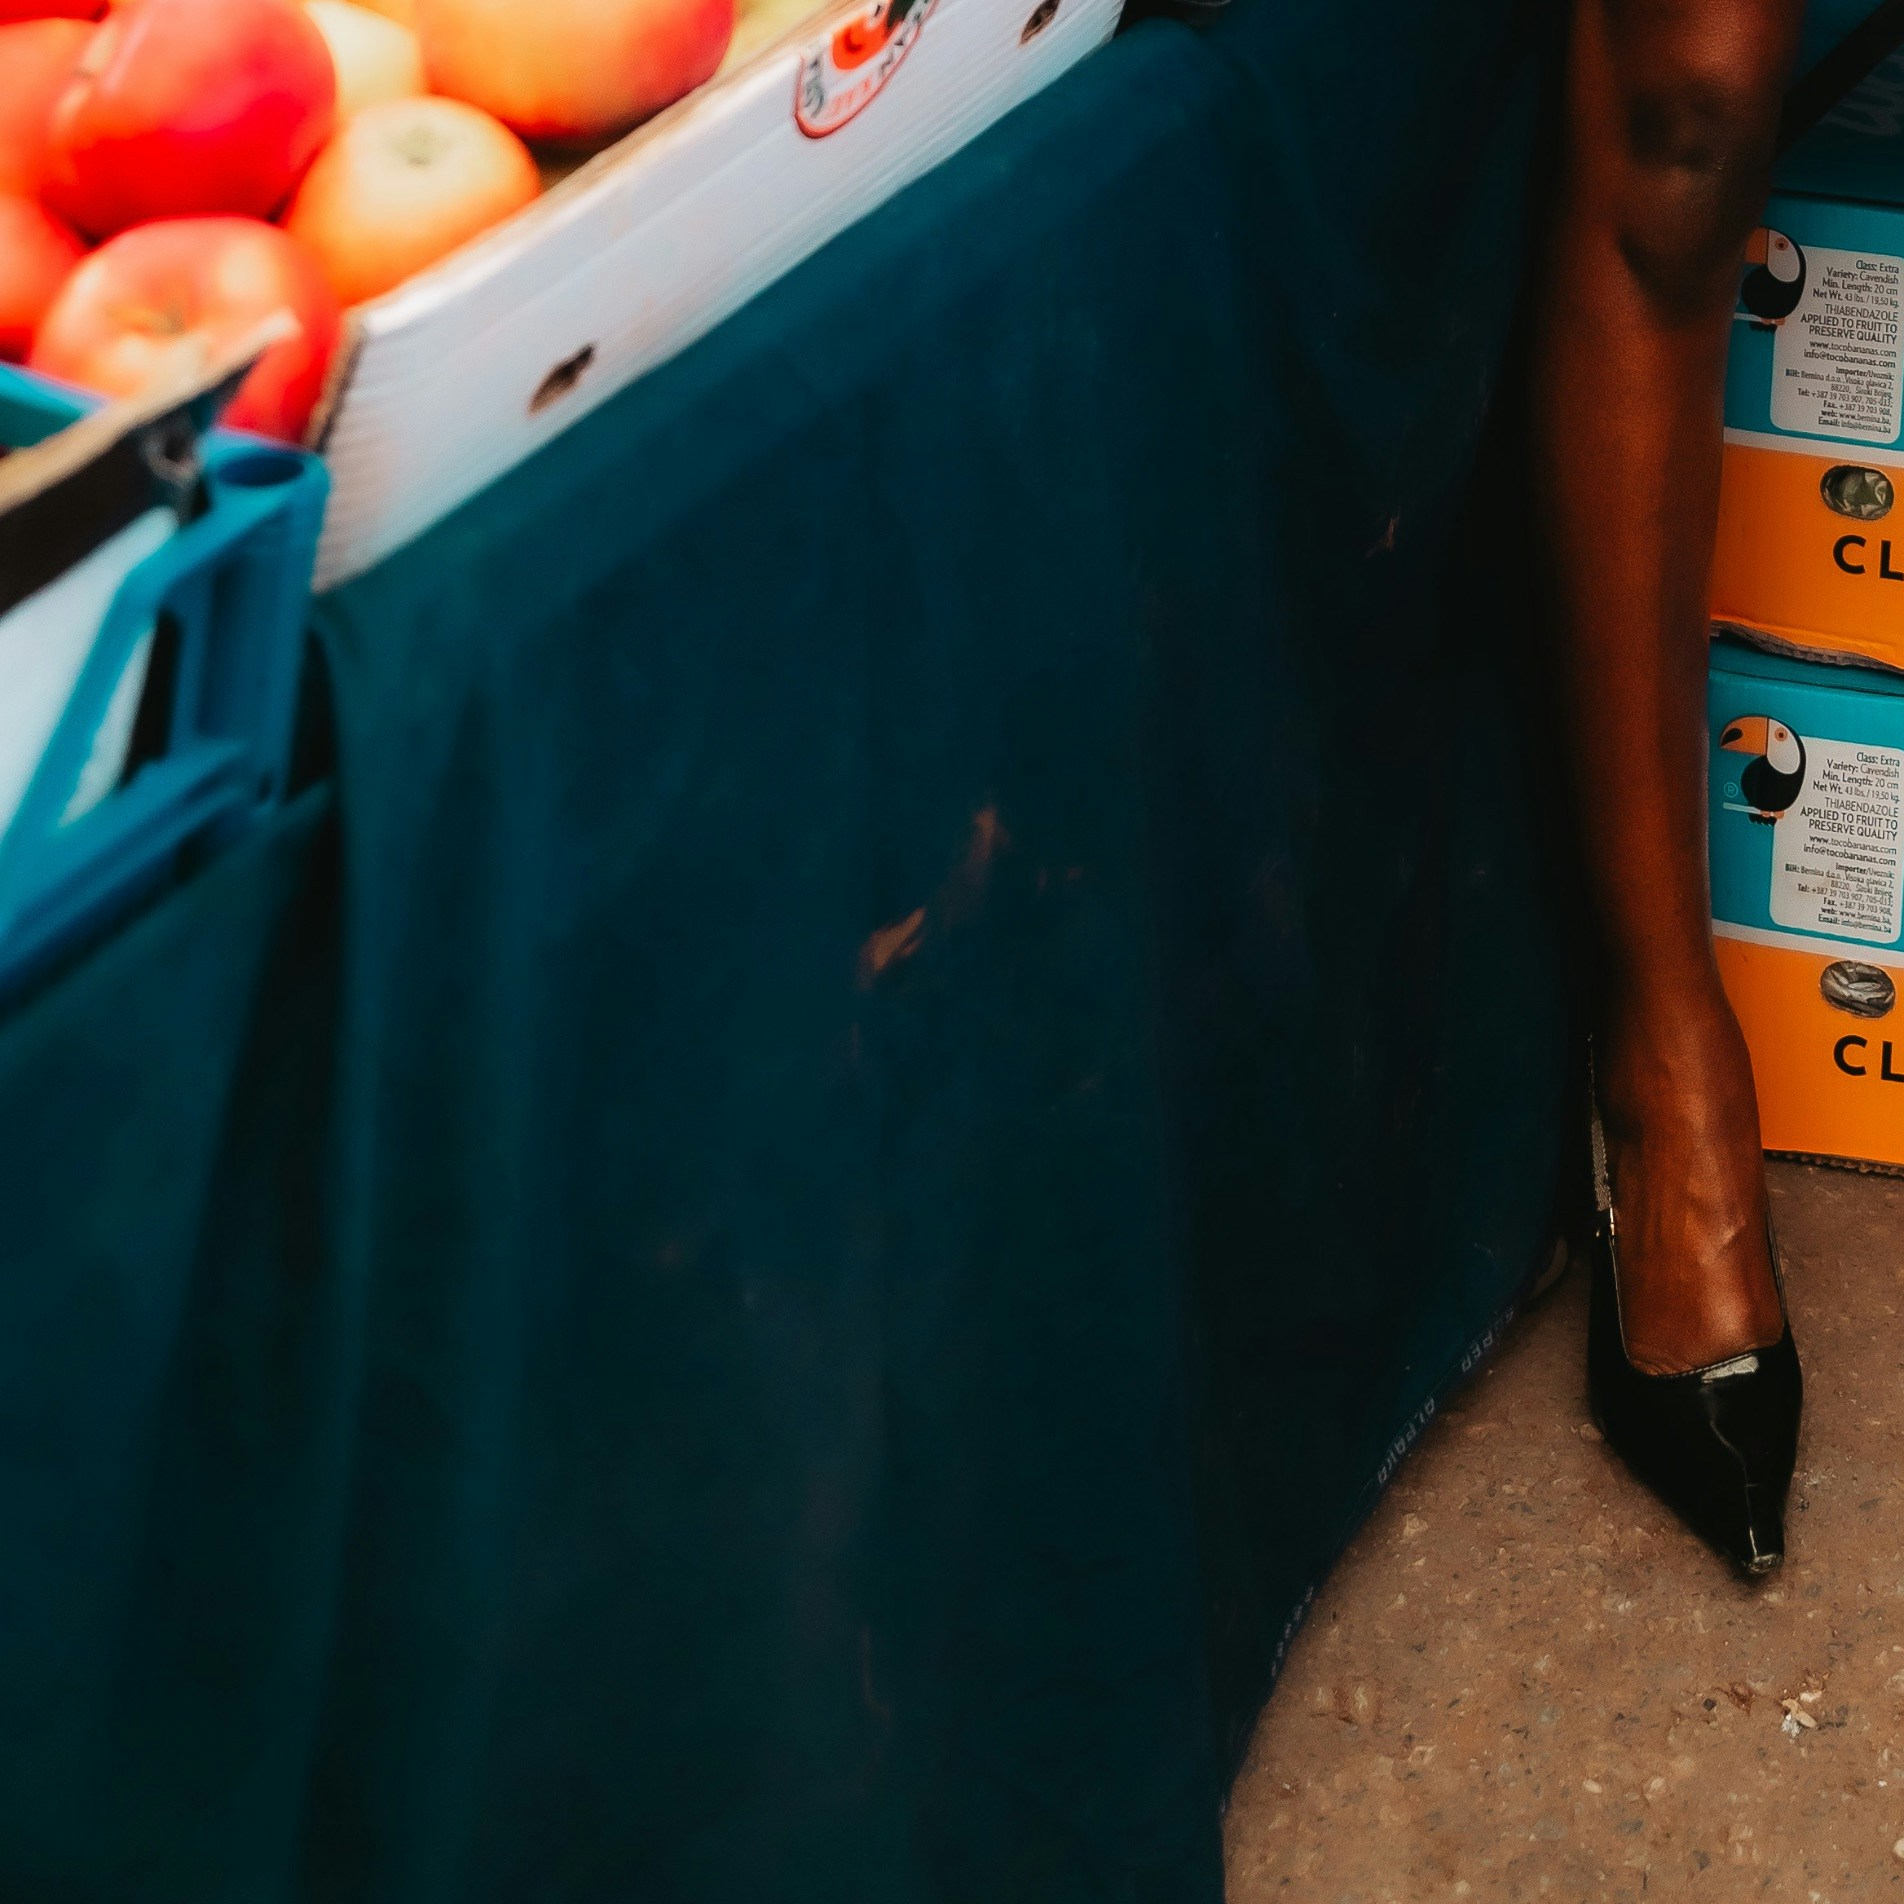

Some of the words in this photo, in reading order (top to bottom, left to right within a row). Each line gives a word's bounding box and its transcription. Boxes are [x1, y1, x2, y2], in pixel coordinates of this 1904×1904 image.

[1827, 267, 1858, 280] Variety:
[1860, 271, 1898, 284] Cavendish
[1880, 263, 1899, 273] Extra
[1813, 288, 1827, 298] Net
[1830, 289, 1842, 300] Wt.
[1845, 293, 1852, 301] 43
[1823, 278, 1838, 288] Min.
[1842, 280, 1872, 293] Length:
[1875, 284, 1884, 293] 20
[1825, 304, 1898, 322] THIABENDAZOLE
[1801, 313, 1839, 326] APPLIED
[1841, 318, 1854, 328] TO
[1856, 319, 1881, 330] FRUIT
[1884, 323, 1897, 333] TO
[1809, 325, 1854, 339] PRESERVE
[1856, 330, 1897, 344] QUALITY
[1810, 341, 1897, 357] www.tocobananas.com
[1804, 349, 1895, 368] info@tocobananas.com
[1827, 759, 1858, 773] Variety:
[1860, 764, 1899, 778] Cavendish
[1881, 755, 1900, 767] Extra
[1813, 781, 1828, 791] Net
[1829, 783, 1843, 793] Wt.
[1845, 786, 1853, 794] 43
[1822, 770, 1840, 781] Min.
[1842, 772, 1873, 786] Length:
[1875, 778, 1885, 787] 20
[1825, 797, 1898, 817] THIABENDAZOLE
[1800, 806, 1839, 820] APPLIED
[1841, 812, 1854, 823] TO
[1856, 814, 1883, 827] FRUIT
[1885, 819, 1898, 830] TO
[1809, 819, 1854, 835] PRESERVE
[1857, 826, 1897, 841] QUALITY
[1810, 835, 1896, 854] www.tocobananas.com
[1804, 844, 1896, 866] info@tocobananas.com
